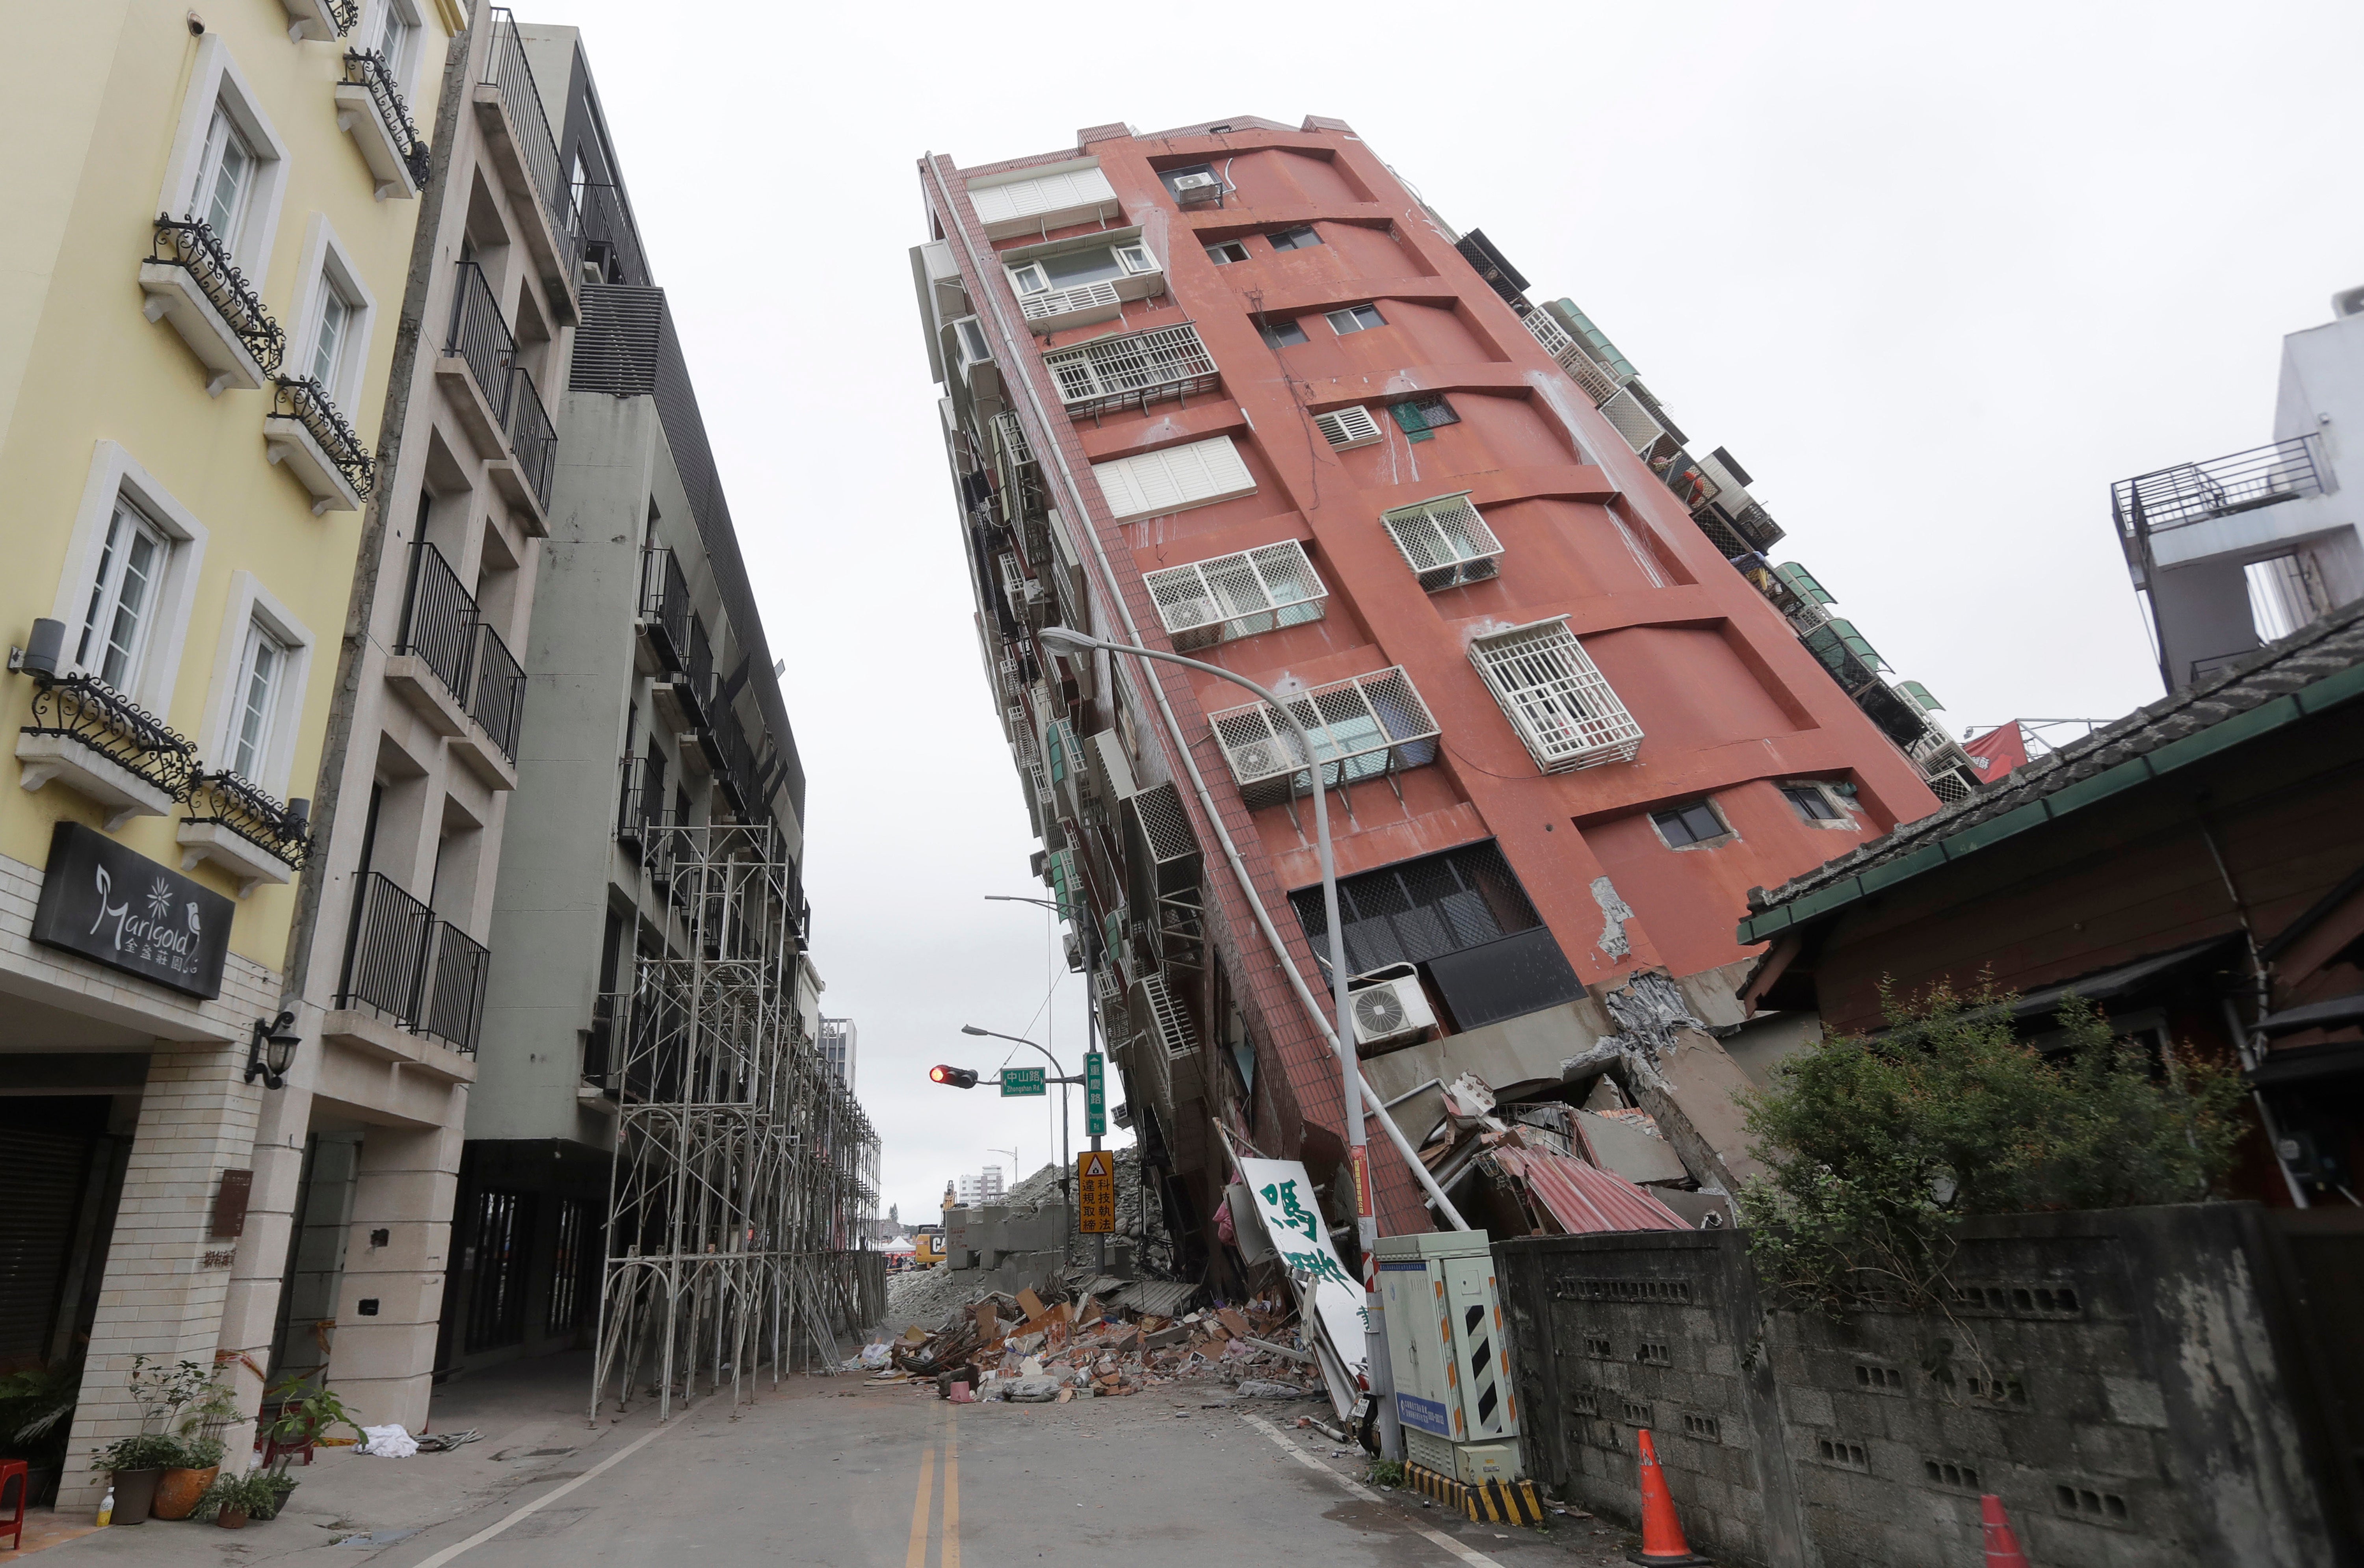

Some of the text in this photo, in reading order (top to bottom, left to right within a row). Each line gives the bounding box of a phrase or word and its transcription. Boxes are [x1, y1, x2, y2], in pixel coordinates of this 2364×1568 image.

[125, 938, 183, 972] 金盞莊園
[1007, 1071, 1040, 1082] 中山路
[1090, 1065, 1101, 1104] 重慶路
[1082, 1179, 1095, 1231] 違規取締
[1098, 1179, 1111, 1230] 科技執法
